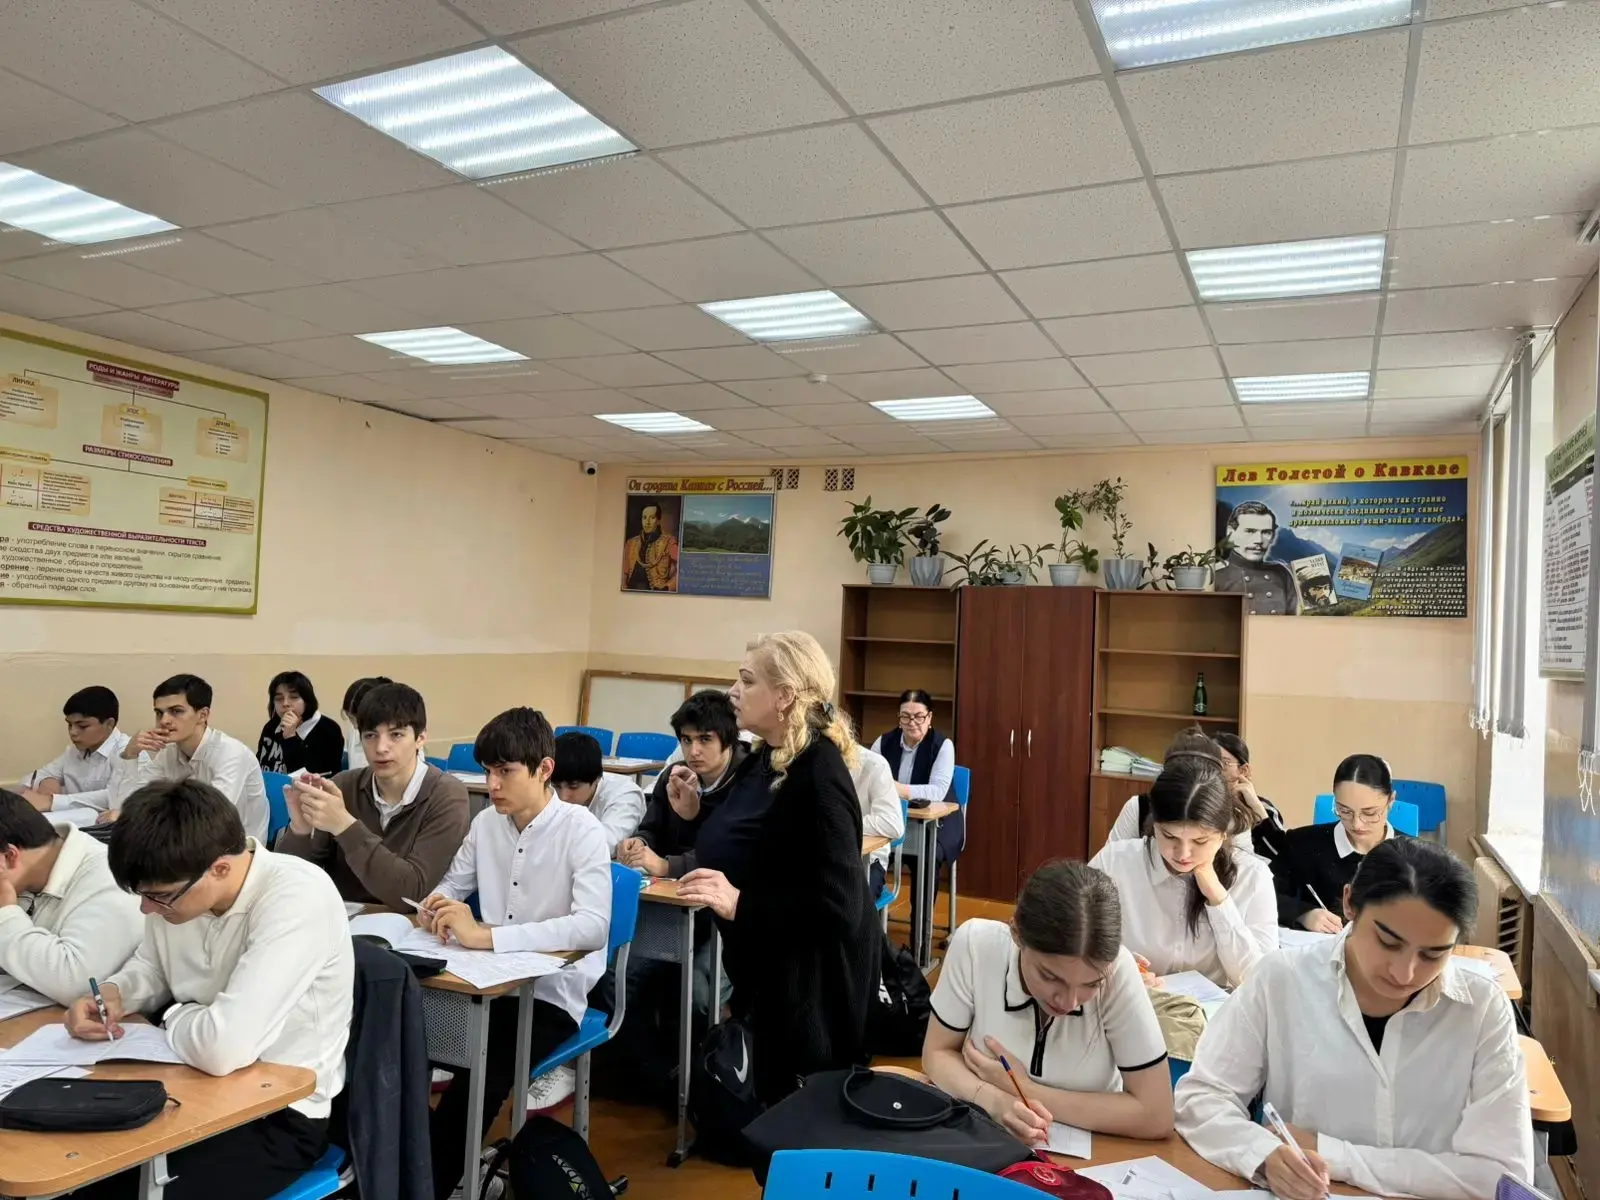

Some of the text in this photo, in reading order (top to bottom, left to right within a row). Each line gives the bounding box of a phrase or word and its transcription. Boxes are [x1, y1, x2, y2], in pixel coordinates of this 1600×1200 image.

[89, 362, 109, 373] РОДЫ
[116, 368, 140, 380] ЖАНРЫ
[142, 376, 179, 389] ЛИТЕРАТУРЫ
[84, 446, 171, 466] РАЗМЕРЫ СТИХОСЛОЖЕНИЯ
[1222, 462, 1460, 482] Лев Толстой о Кавказе
[1360, 496, 1393, 505] котором
[1412, 495, 1447, 504] странно
[1288, 518, 1360, 528] противоположные
[32, 523, 65, 533] СРЕДСТВА
[66, 525, 127, 539] ХУДОЖЕСТВЕННОЙ
[128, 532, 185, 544] ВЫРАЗИТЕЛЬНОСТИ
[16, 537, 67, 548] употребление
[10, 546, 43, 555] сходства
[63, 551, 99, 560] предметов
[1, 554, 62, 565] художественное
[68, 559, 99, 568] образное
[16, 573, 64, 584] уподобление
[36, 565, 82, 575] перенесение
[134, 573, 163, 582] существа
[12, 581, 47, 590] обратный
[49, 584, 78, 592] порядок
